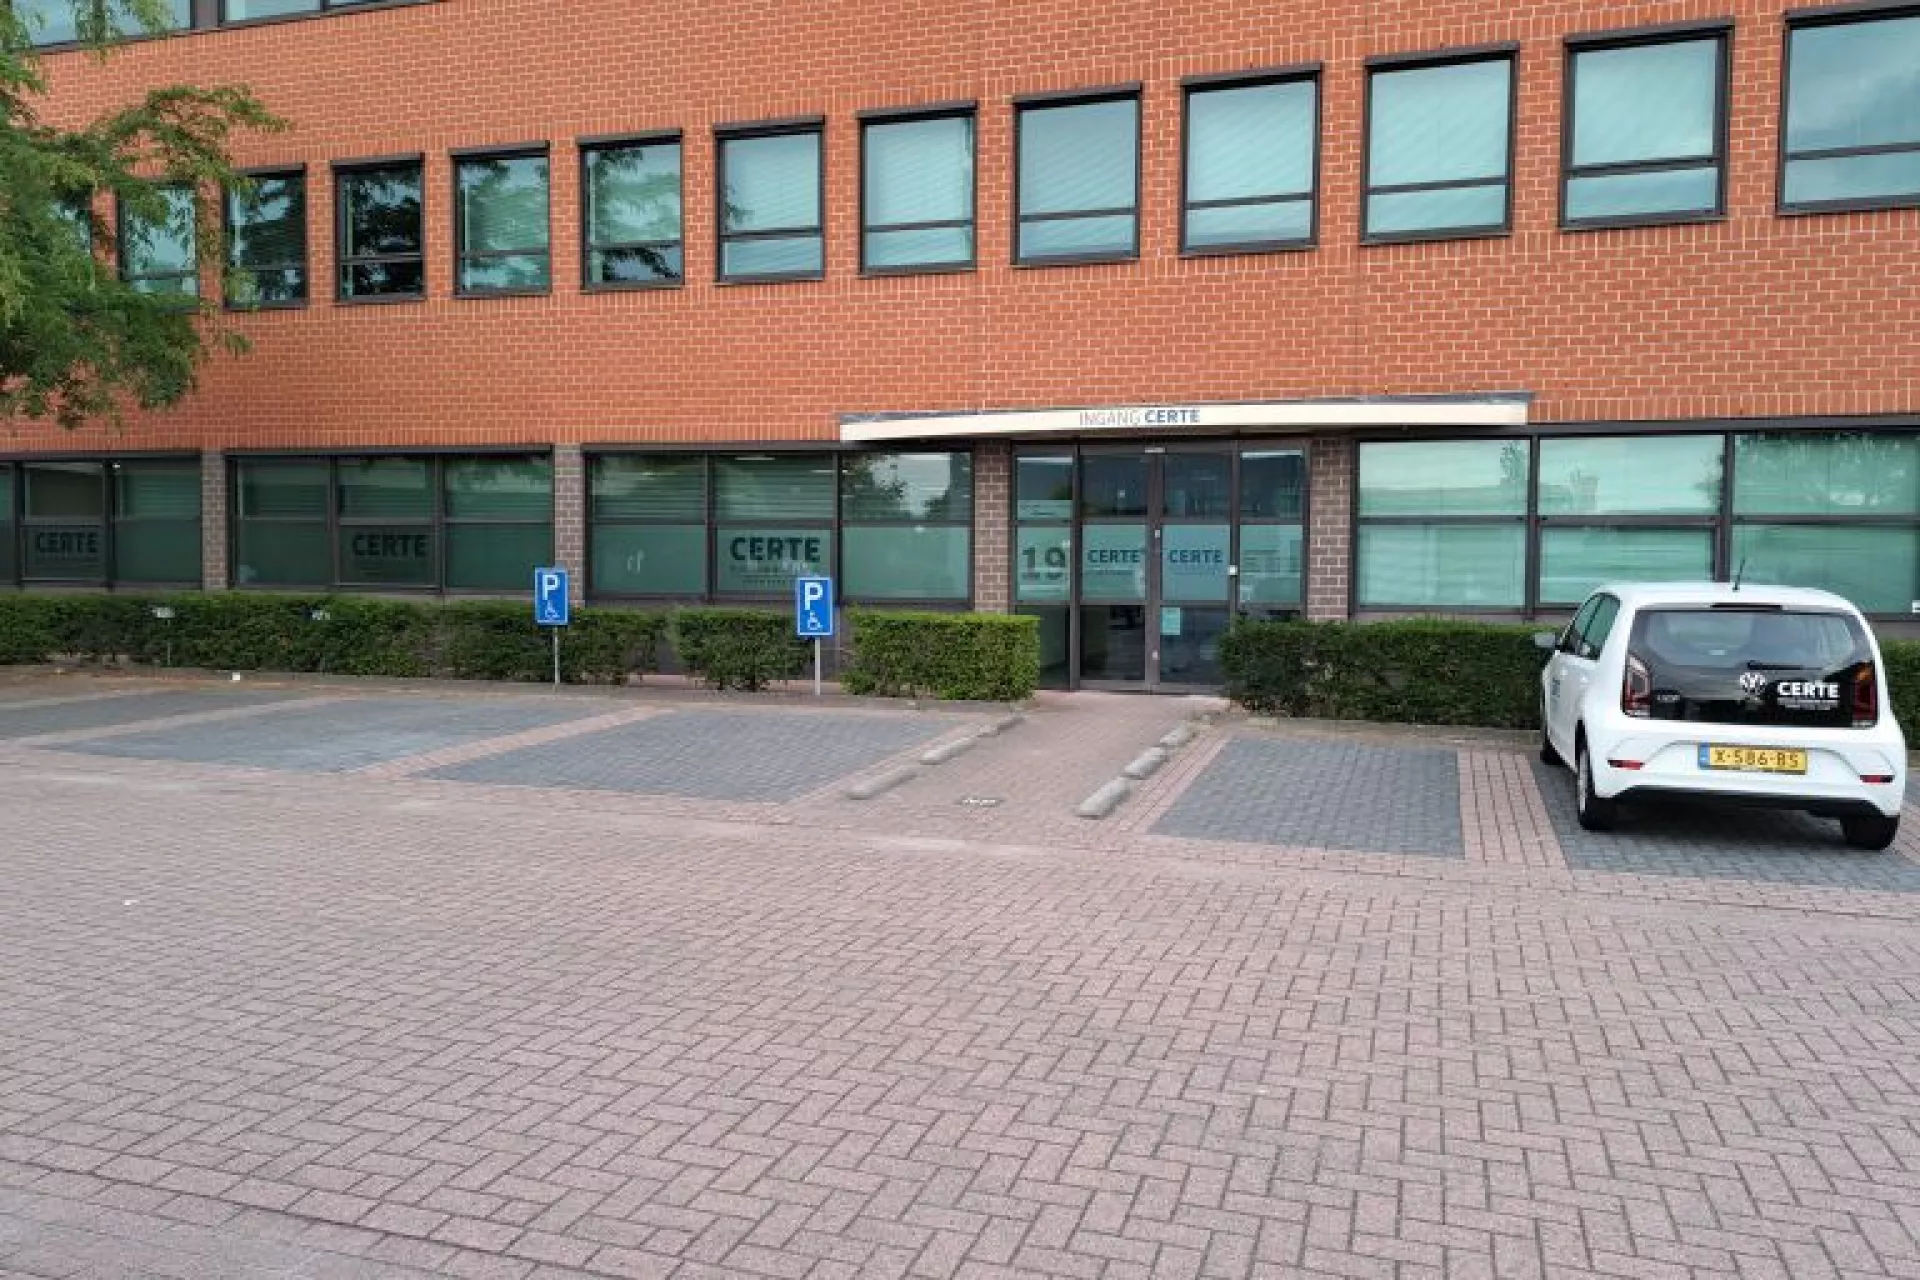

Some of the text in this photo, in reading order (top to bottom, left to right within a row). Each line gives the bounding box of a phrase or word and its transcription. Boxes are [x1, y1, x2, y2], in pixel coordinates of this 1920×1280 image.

[1144, 409, 1200, 423] CERTE
[35, 531, 98, 553] CERTE
[353, 534, 427, 557] CERTE
[731, 537, 820, 562] CERTE
[1087, 549, 1141, 564] CERTE
[1169, 549, 1223, 563] CERTE
[542, 574, 560, 600] P
[804, 582, 823, 610] P
[1777, 682, 1840, 699] CERTE
